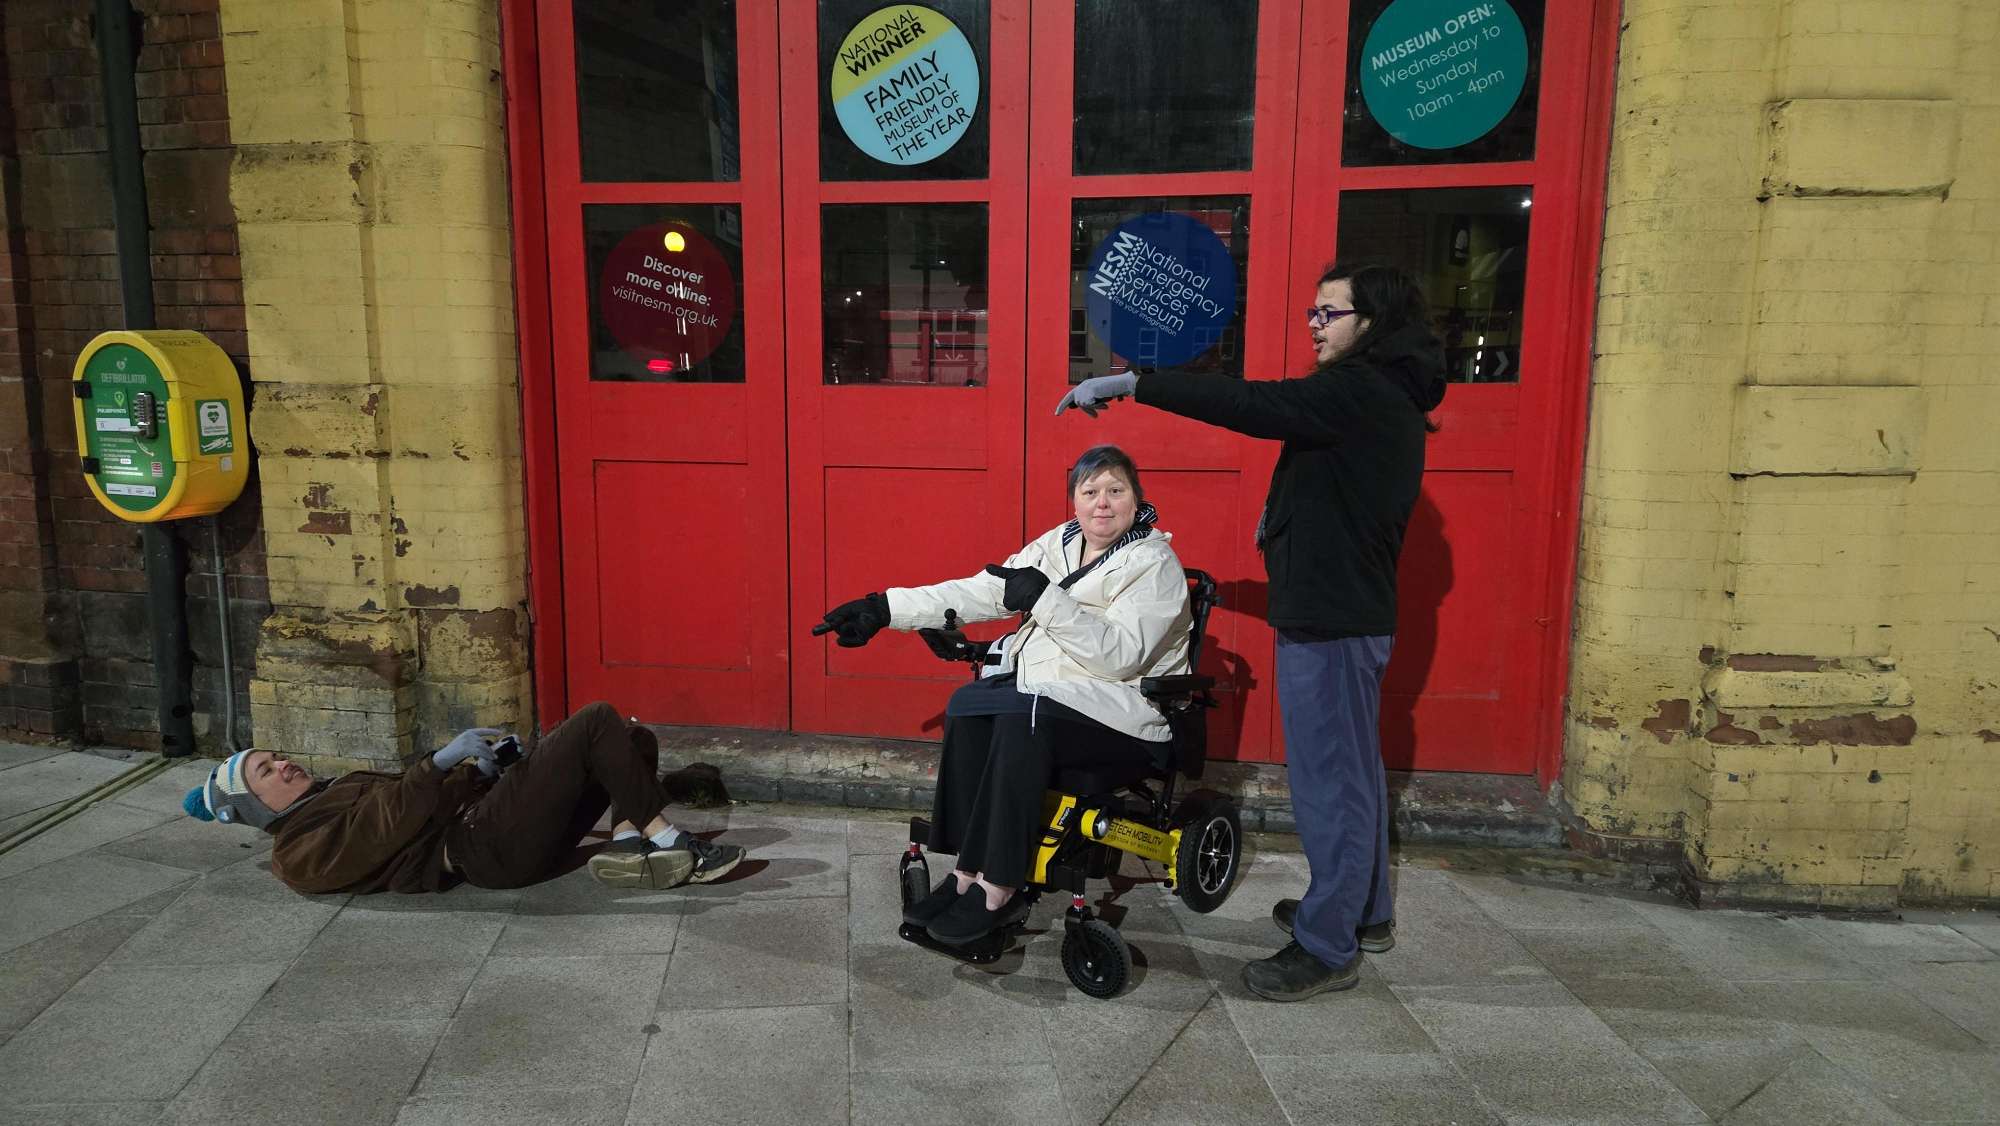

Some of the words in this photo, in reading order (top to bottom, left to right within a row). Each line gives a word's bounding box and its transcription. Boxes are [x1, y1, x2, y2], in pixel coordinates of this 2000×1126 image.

[840, 9, 919, 65] NATIONAL
[846, 22, 926, 77] WINNER
[1371, 28, 1442, 71] MUSEUM
[1444, 3, 1496, 35] OPEN:
[1379, 35, 1479, 88] Wednesday
[1482, 25, 1501, 41] to
[863, 50, 941, 113] FAMILY
[875, 73, 952, 131] FRIENDLY
[1406, 93, 1453, 121] 10am
[1467, 69, 1505, 94] 4pm
[1415, 58, 1478, 95] Sunday
[883, 105, 940, 146] MUSEUM
[941, 90, 960, 109] OF
[891, 132, 928, 161] THE
[924, 107, 971, 141] YEAR
[626, 271, 662, 291] more
[665, 283, 712, 306] online:
[643, 255, 704, 284] Discover
[1089, 230, 1139, 297] NESM
[1132, 255, 1225, 318] Emergency
[1139, 242, 1211, 291] National
[612, 286, 719, 328] visitnesm.org.uk
[1116, 283, 1184, 332] Museum
[1124, 269, 1189, 316] Services
[1138, 312, 1177, 337] imagination
[1109, 821, 1131, 837] ETECH
[1131, 829, 1163, 845] MOBILITY
